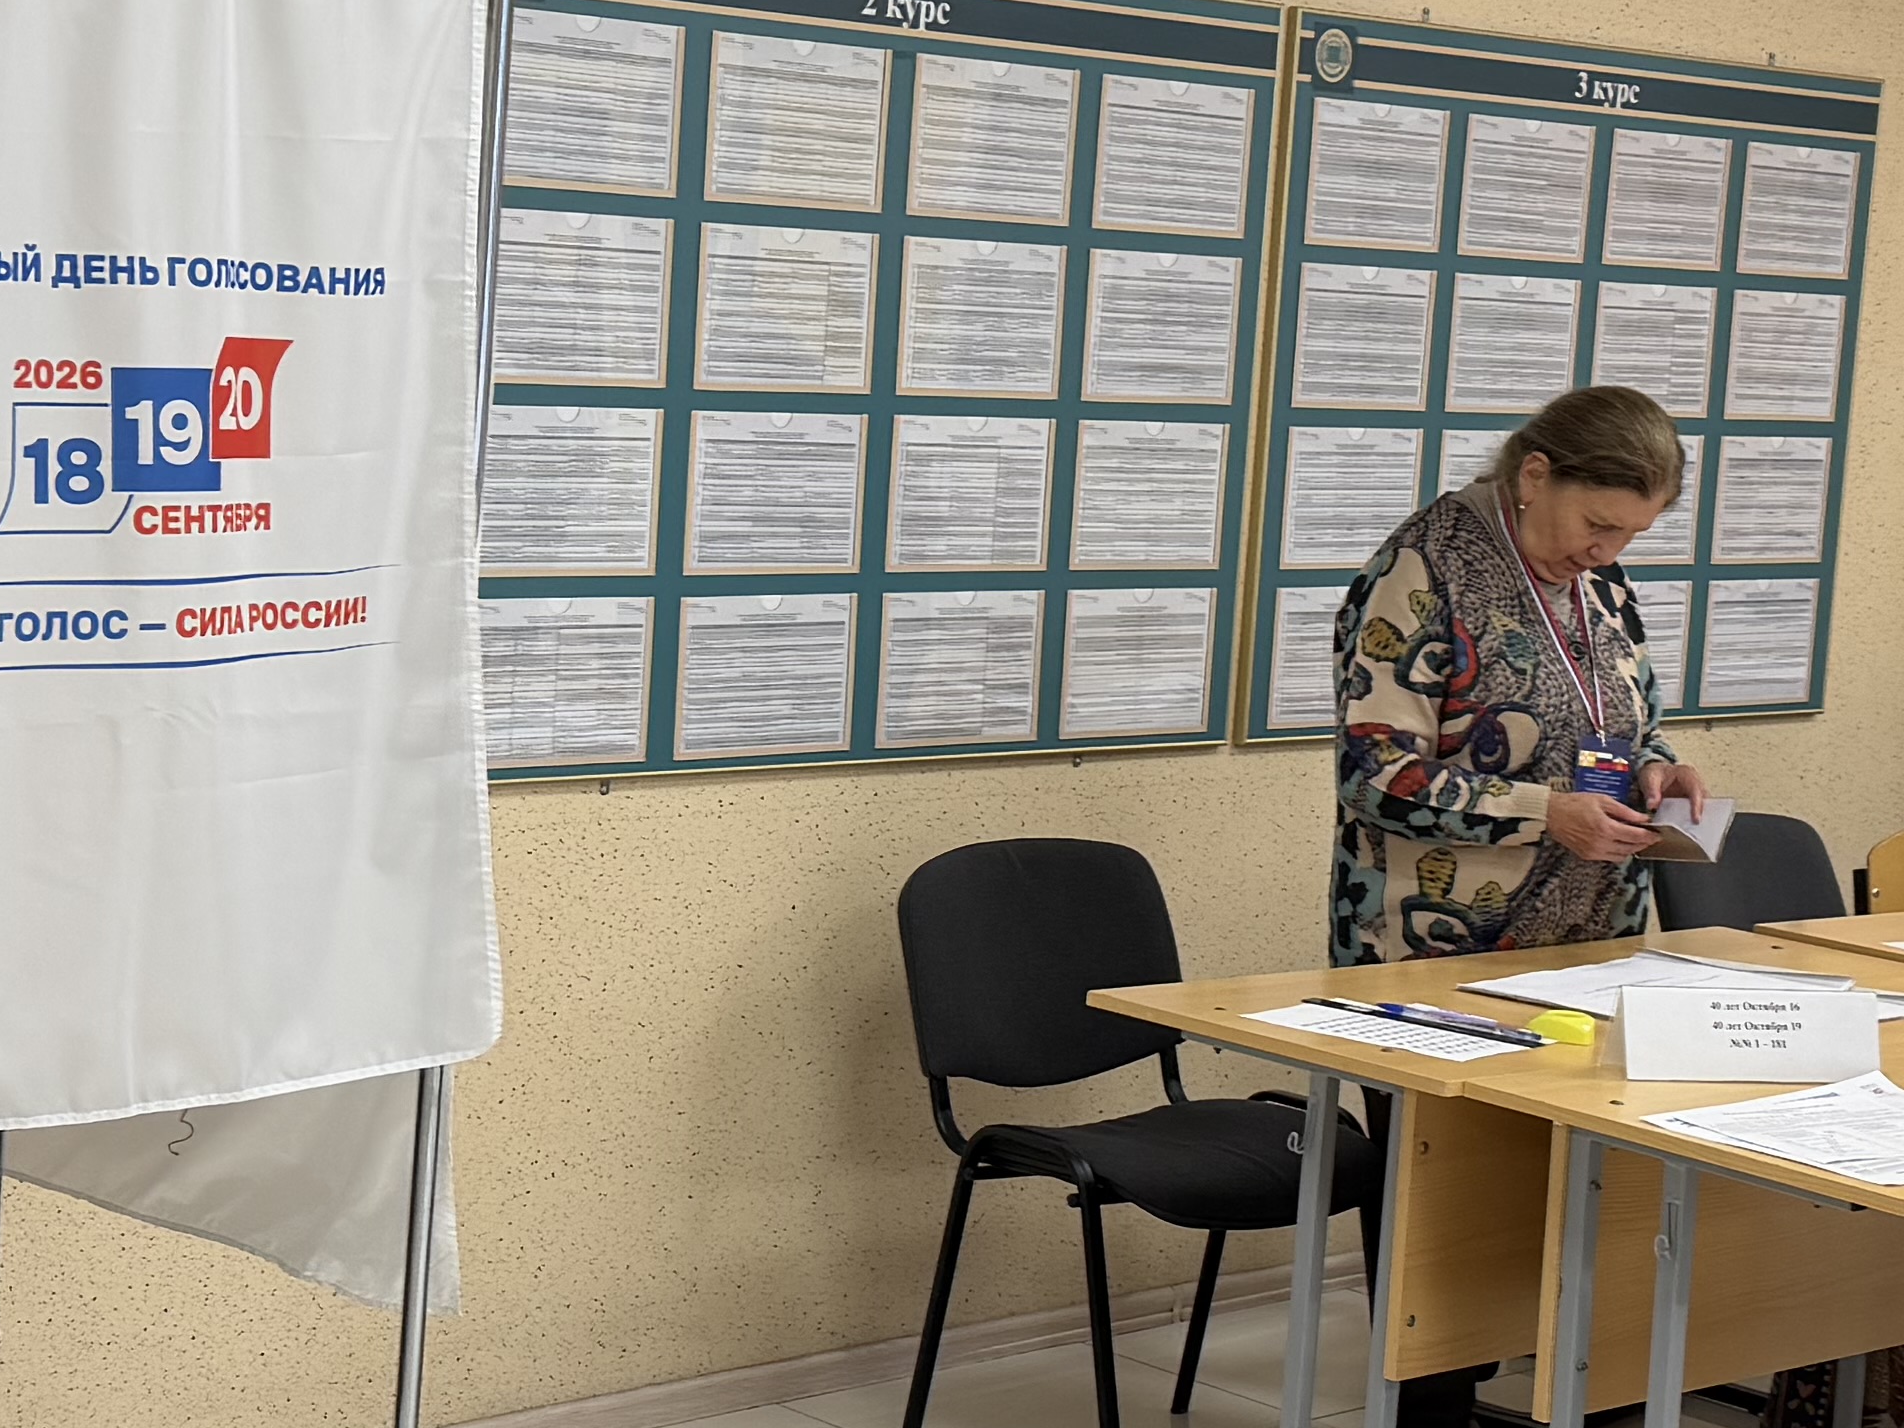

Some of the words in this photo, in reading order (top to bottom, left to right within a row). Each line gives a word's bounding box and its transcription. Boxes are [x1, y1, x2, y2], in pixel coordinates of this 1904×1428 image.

[1574, 71, 1589, 99] 3
[1592, 80, 1641, 110] курс
[51, 252, 161, 291] ДЕНЬ
[13, 358, 105, 391] 2026
[22, 436, 106, 507] 18
[124, 398, 204, 467] 19
[218, 365, 263, 431] 20
[175, 605, 245, 639] СИЛА
[248, 596, 368, 632] РОССИИ!
